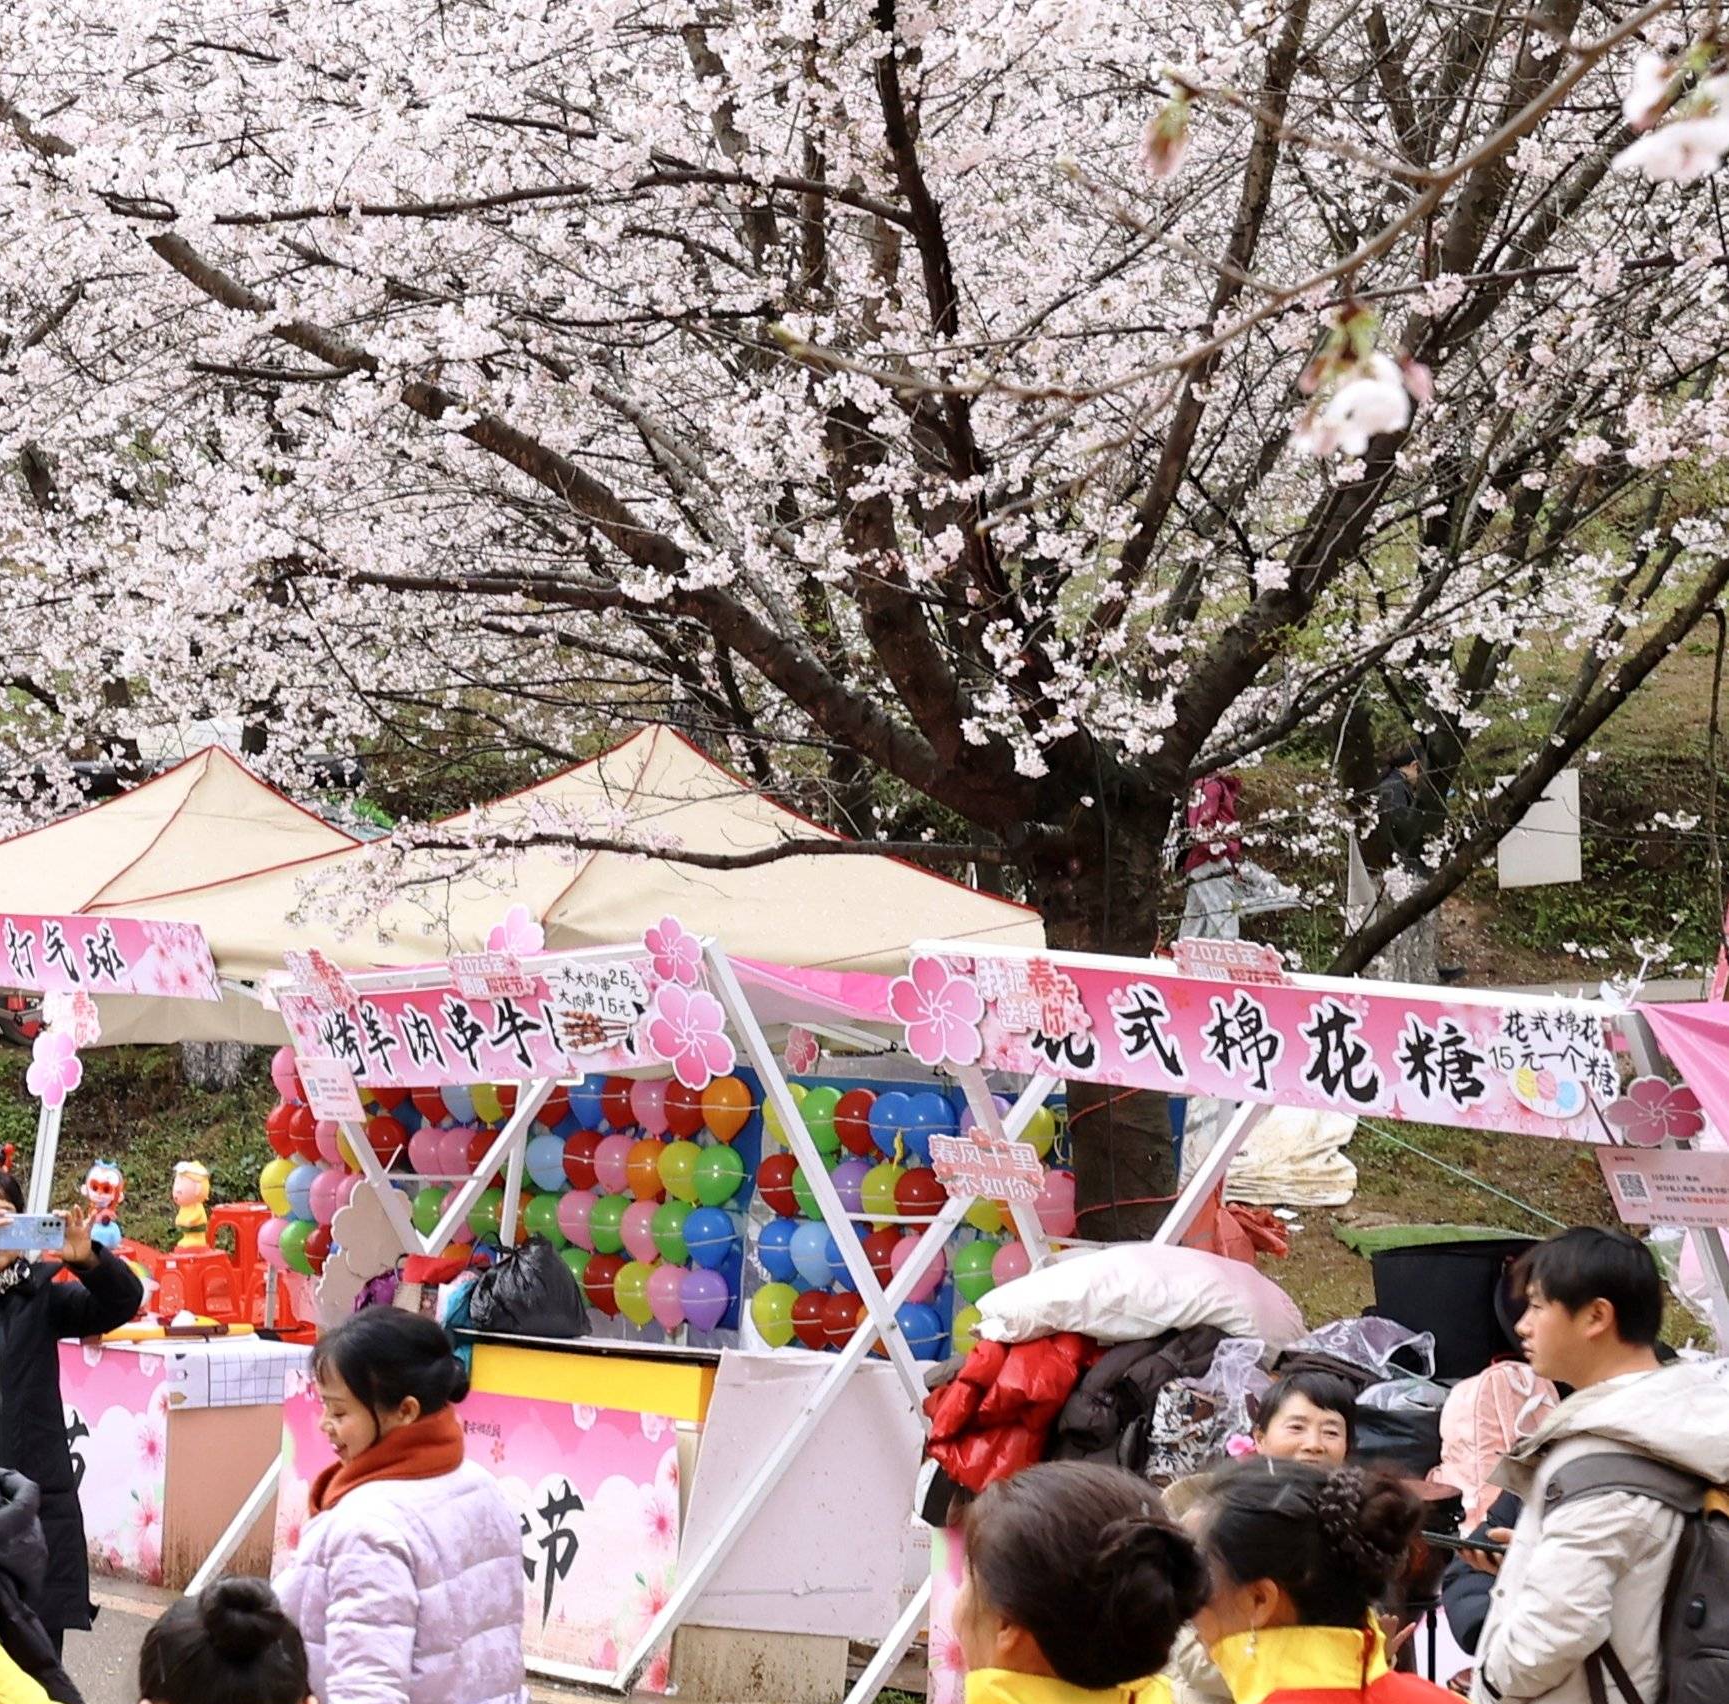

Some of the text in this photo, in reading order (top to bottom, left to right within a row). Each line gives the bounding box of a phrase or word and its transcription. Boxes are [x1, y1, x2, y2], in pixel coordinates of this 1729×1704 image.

[6, 920, 125, 983] 打气球
[1187, 944, 1260, 967] 2026年
[934, 1141, 1038, 1172] 春风十里
